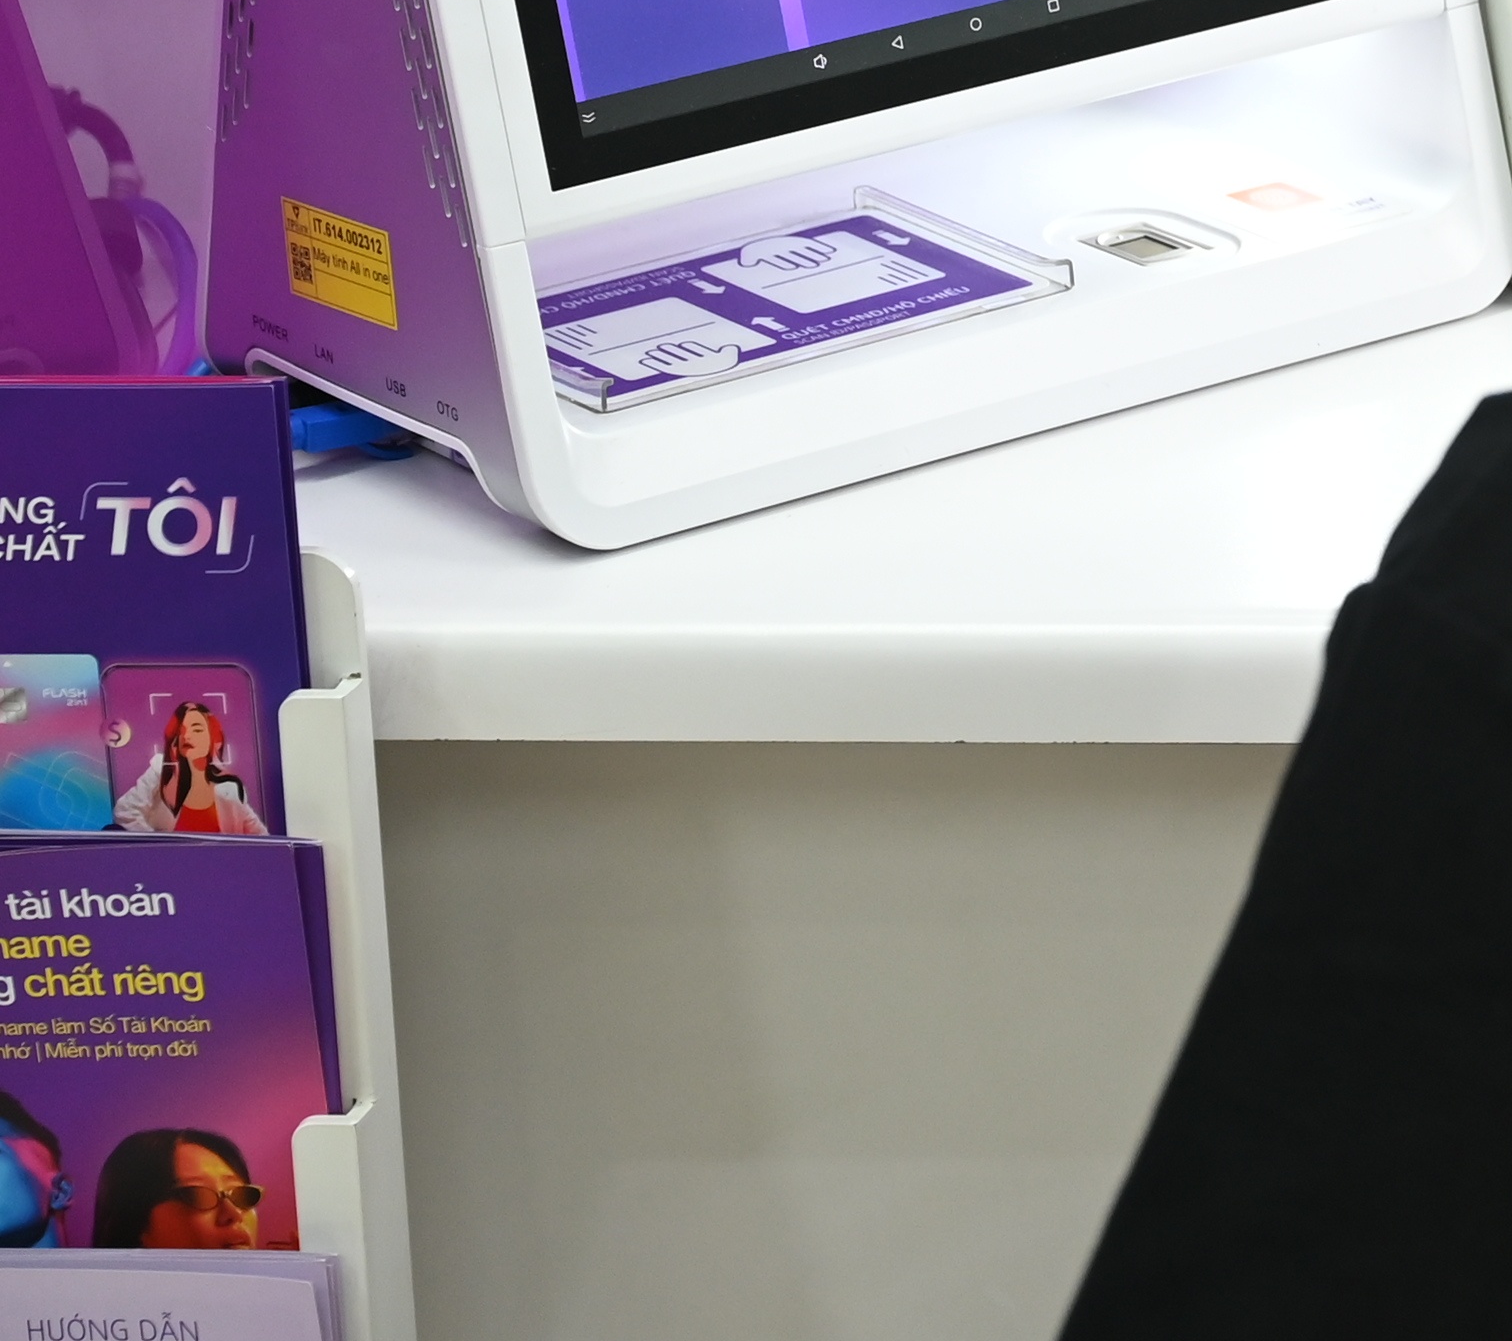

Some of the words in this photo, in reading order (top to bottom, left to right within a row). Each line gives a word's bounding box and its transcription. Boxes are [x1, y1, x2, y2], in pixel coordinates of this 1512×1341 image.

[312, 217, 383, 255] IT.614.002312
[252, 314, 289, 342] POWER
[314, 344, 334, 364] LAN
[385, 377, 407, 397] USB
[436, 400, 460, 422] OTG
[96, 477, 238, 557] TÔI
[0, 521, 85, 561] HẤT
[42, 687, 87, 699] FLASH
[4, 889, 52, 921] tài
[59, 883, 176, 918] khoản
[23, 962, 107, 998] chất
[113, 963, 205, 1003] riêng
[52, 1018, 85, 1035] làm
[89, 1014, 116, 1035] Số
[117, 1017, 147, 1035] Tài
[151, 1015, 211, 1034] Khoản
[44, 1038, 90, 1060] Miễn
[95, 1040, 123, 1062] phí
[126, 1041, 163, 1061] trọn
[166, 1039, 199, 1058] đời
[26, 1313, 129, 1341] HƯỚNG
[138, 1311, 200, 1341] DẪN
